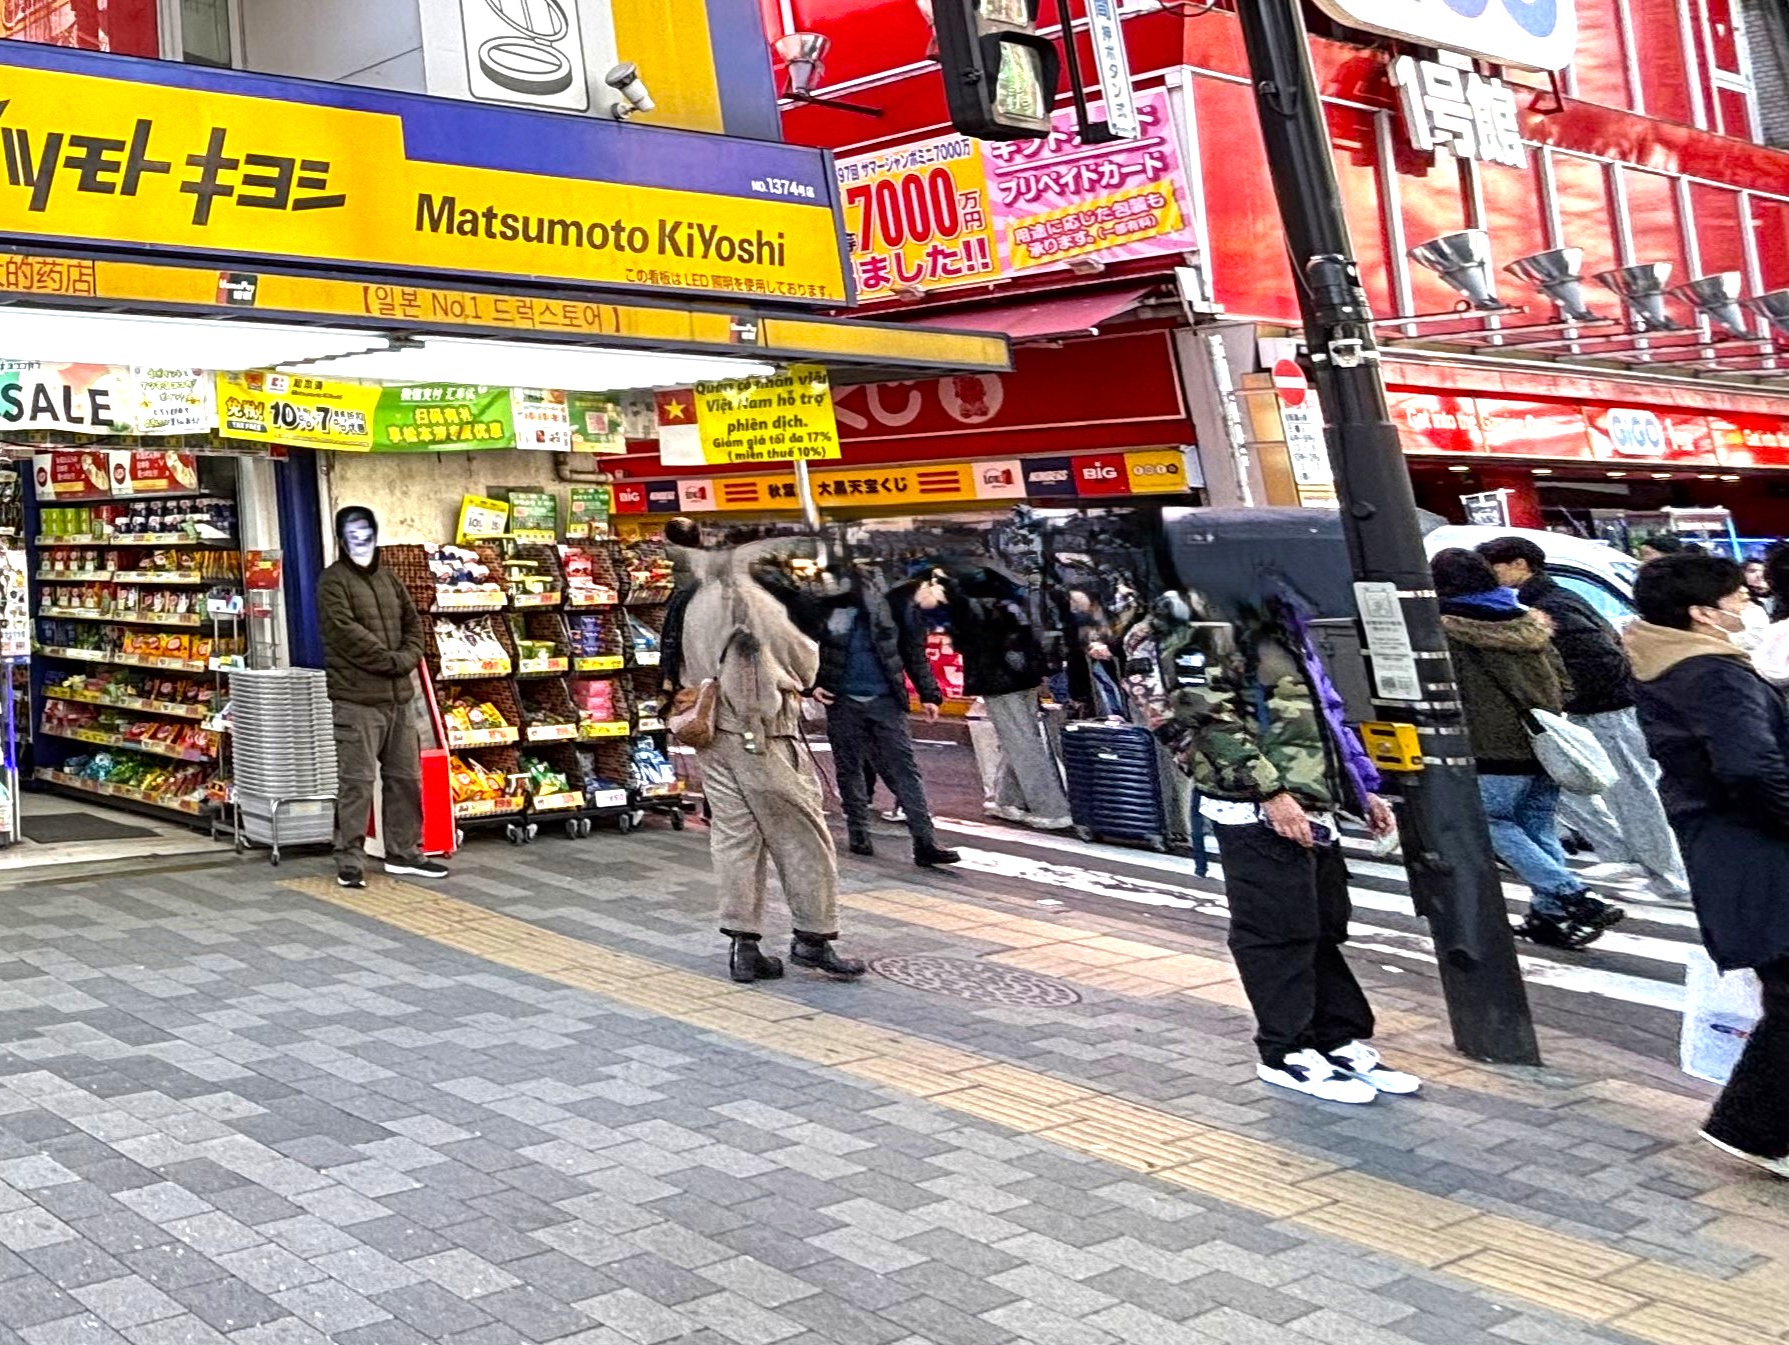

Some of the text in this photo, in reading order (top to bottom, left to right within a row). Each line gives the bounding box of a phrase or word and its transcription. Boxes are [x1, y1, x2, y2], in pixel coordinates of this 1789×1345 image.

[415, 192, 650, 256] Matsumoto
[658, 218, 785, 267] KiYoshi
[432, 294, 482, 320] No.1
[1, 382, 115, 428] SALE
